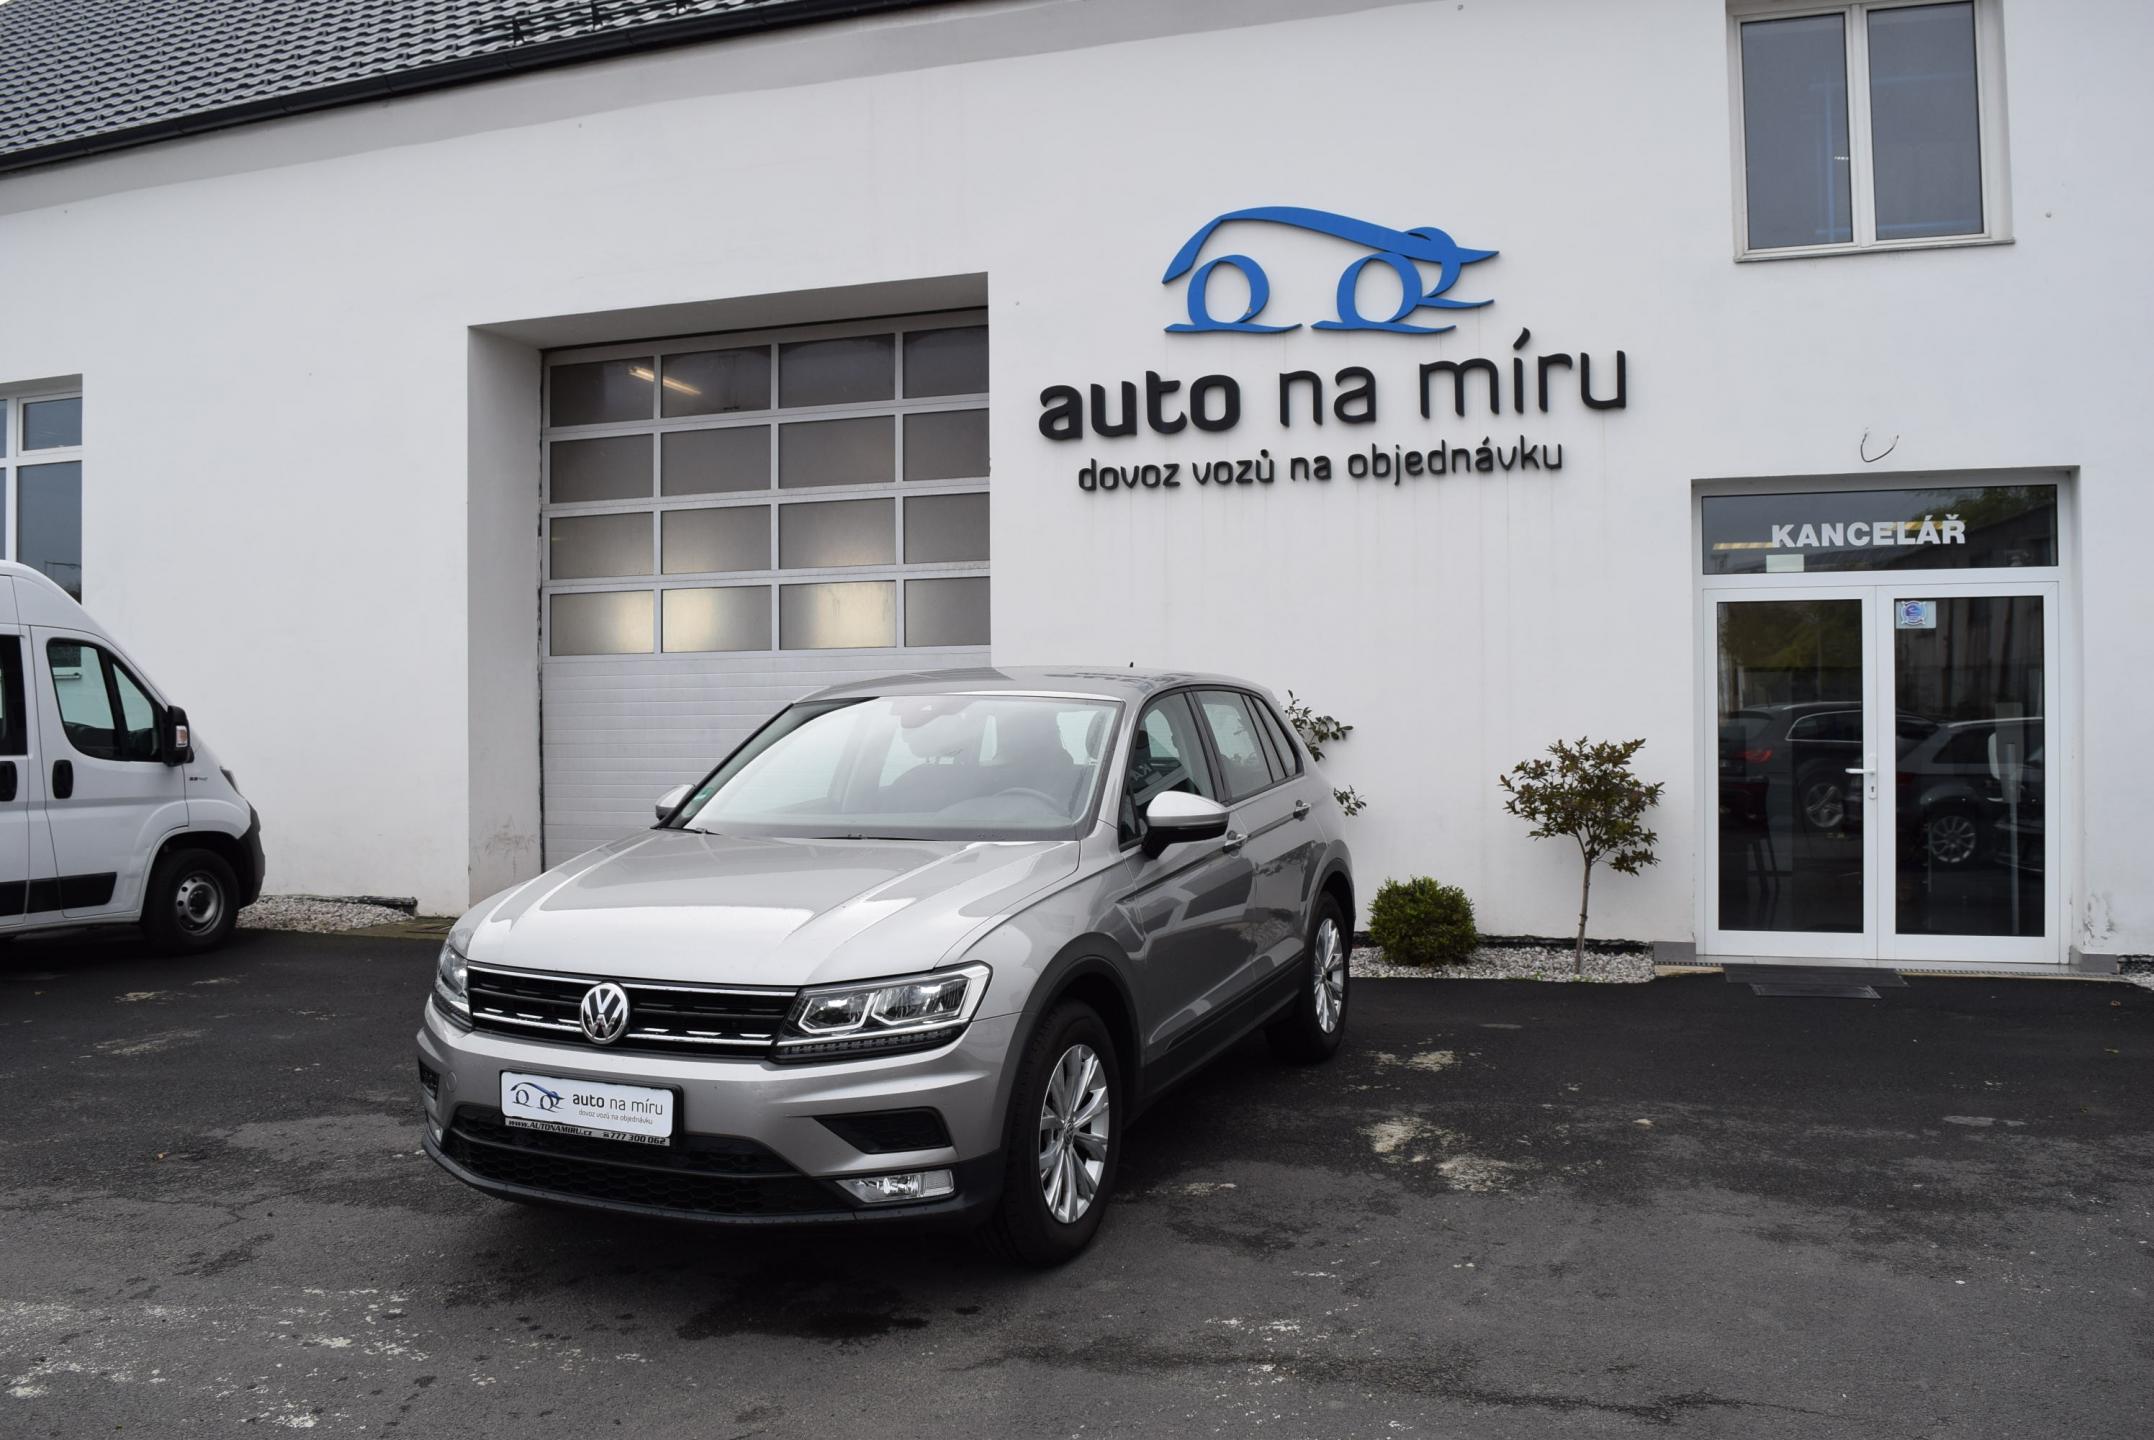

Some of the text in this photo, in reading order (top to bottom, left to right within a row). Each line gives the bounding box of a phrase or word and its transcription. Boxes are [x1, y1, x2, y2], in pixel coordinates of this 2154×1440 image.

[1038, 327, 1627, 443] auto na míru
[1078, 434, 1563, 493] dovoz vozů na objednávku
[1770, 514, 1967, 548] KANCELÁŘ
[572, 1093, 663, 1116] auto na míru
[629, 1134, 647, 1143] 300
